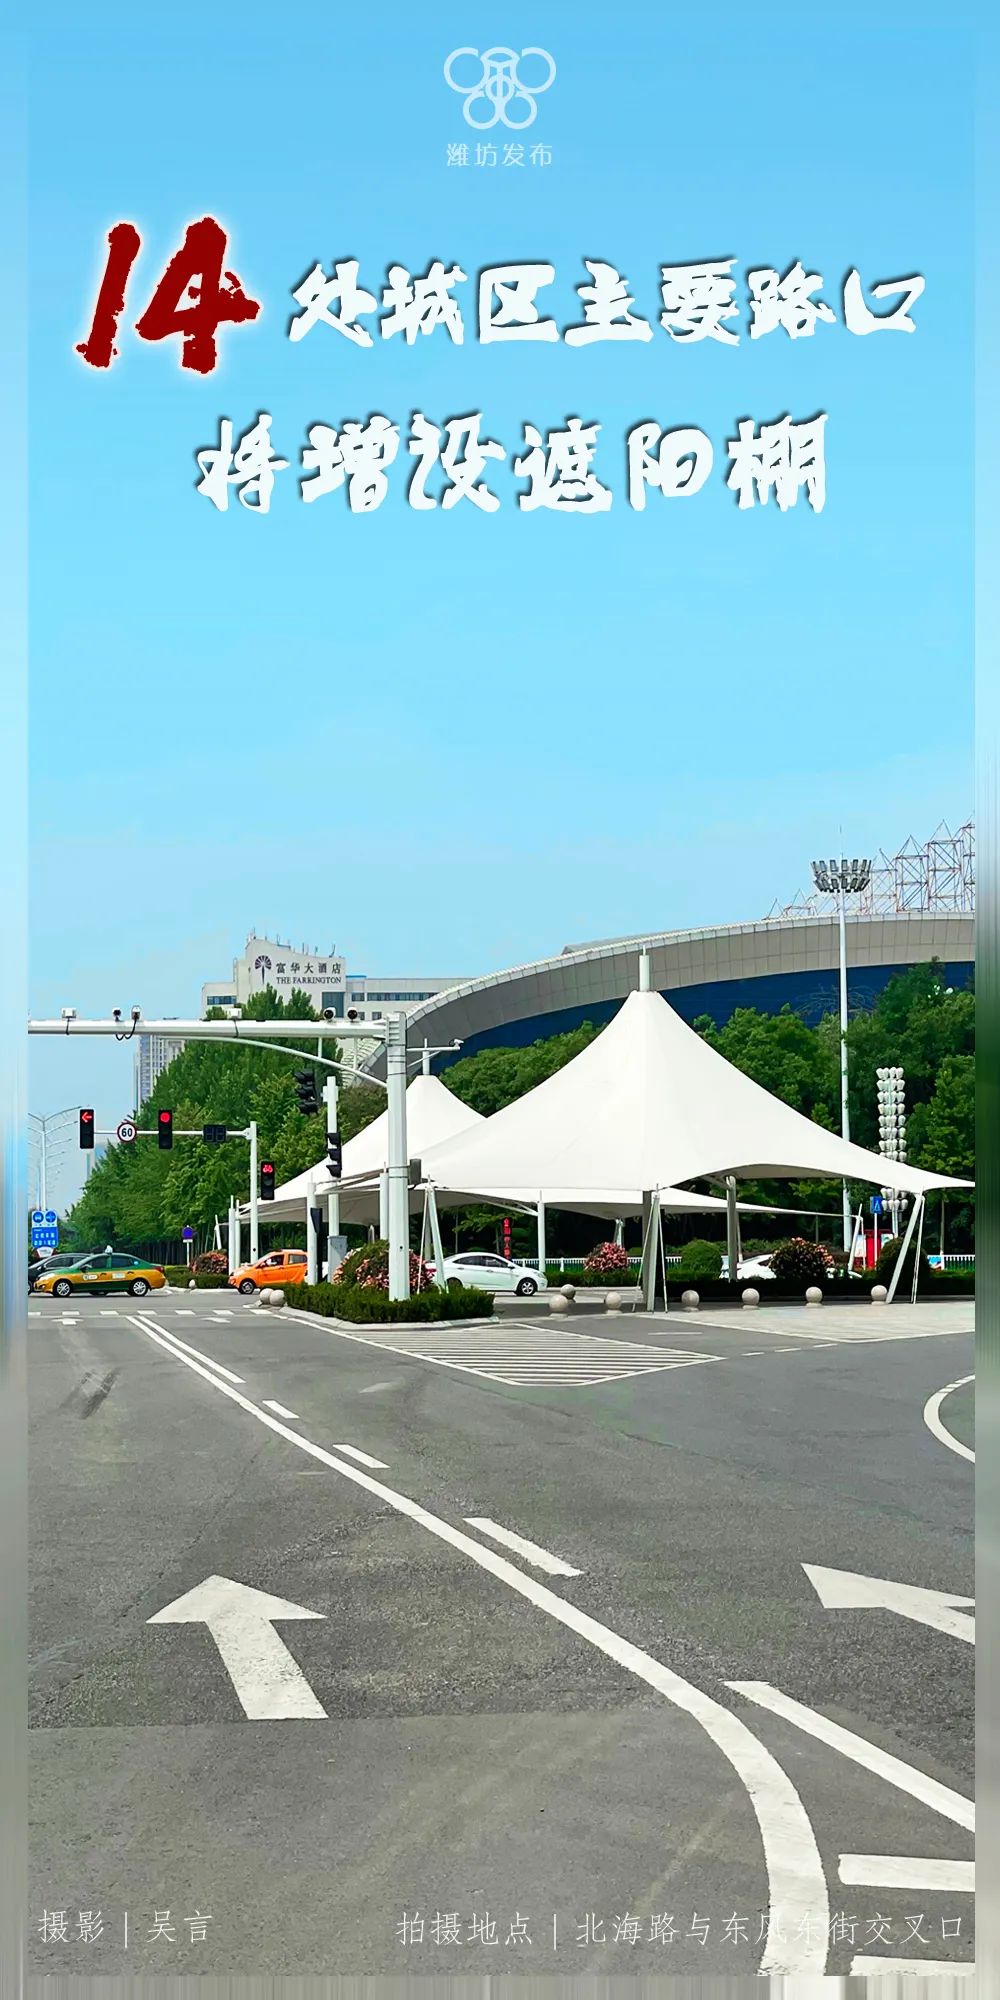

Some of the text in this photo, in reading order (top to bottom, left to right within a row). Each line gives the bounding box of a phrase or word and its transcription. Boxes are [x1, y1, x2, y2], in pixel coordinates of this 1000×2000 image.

[276, 962, 341, 974] 富华大酒店
[276, 976, 341, 984] THE FARRINGTON
[121, 1127, 133, 1138] 60
